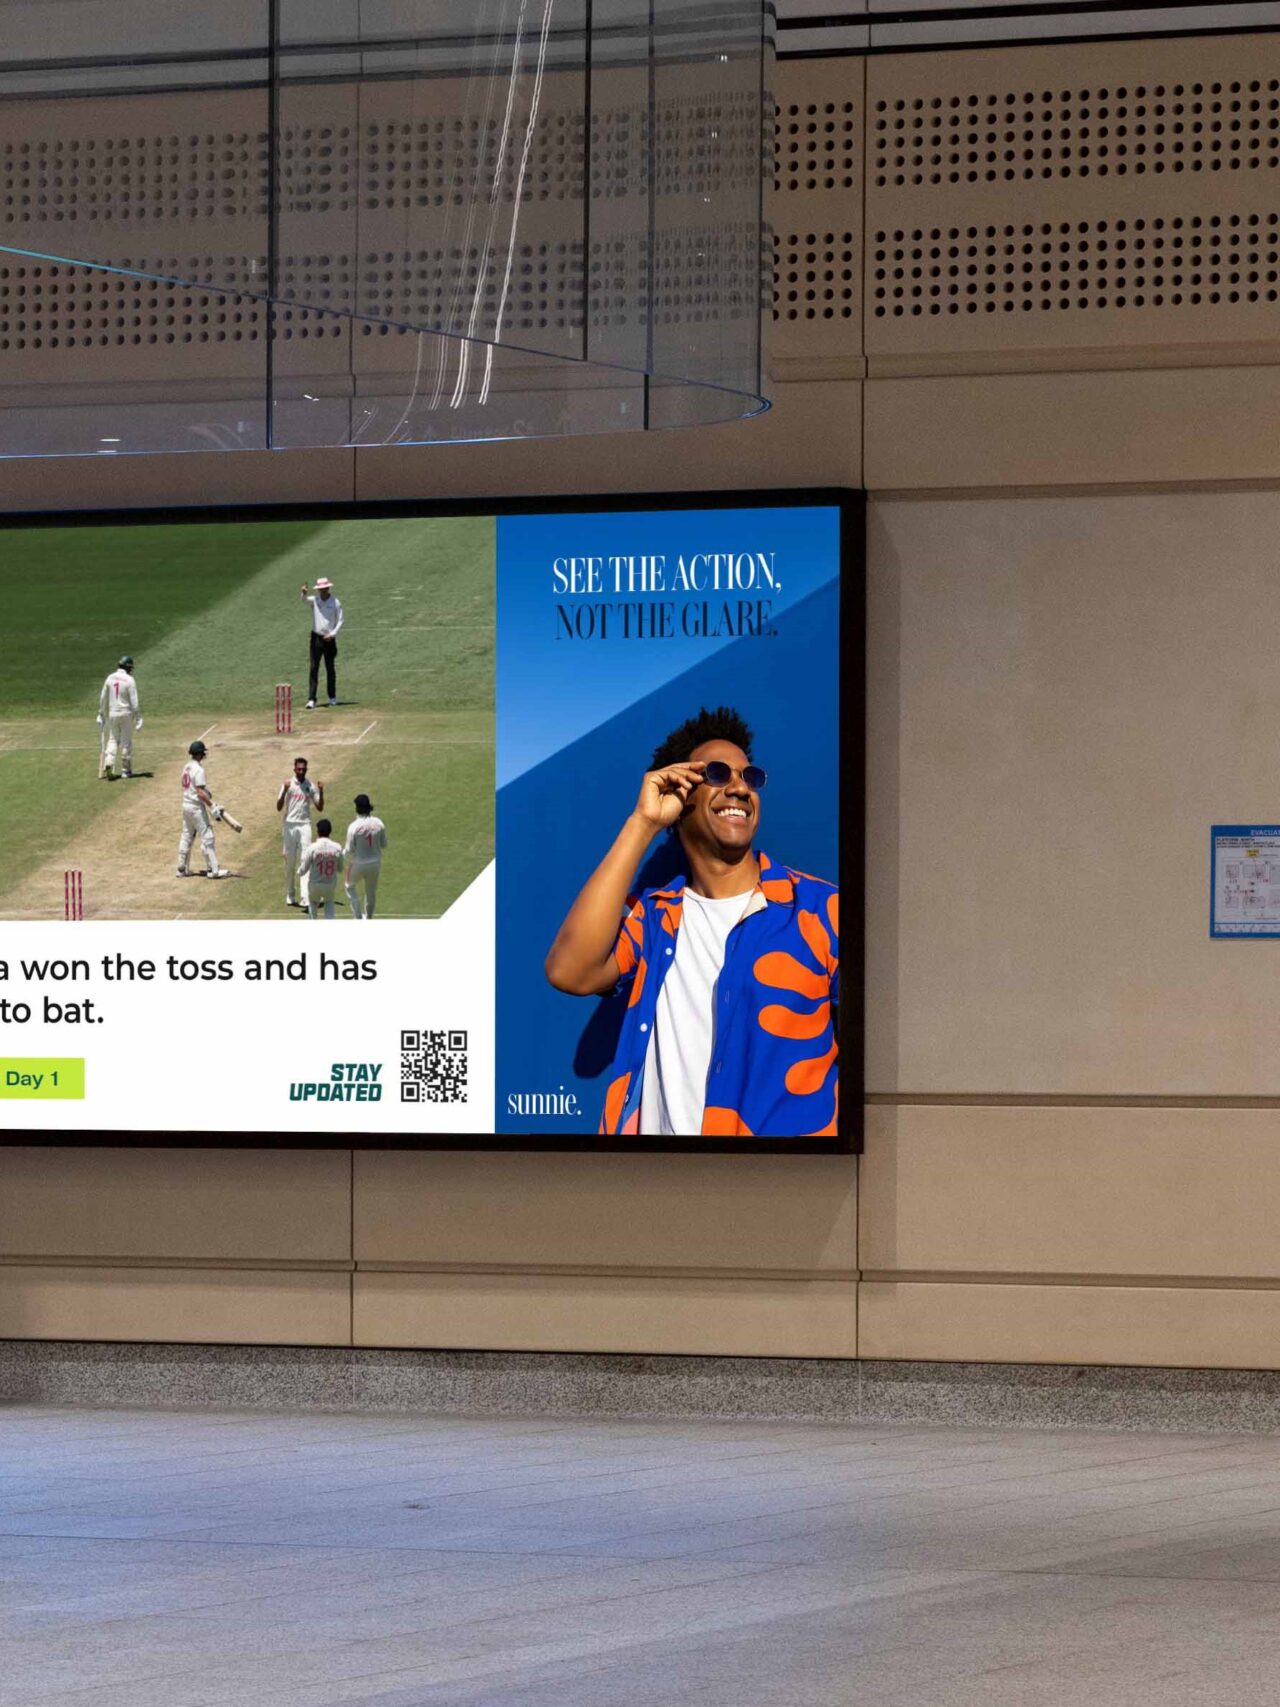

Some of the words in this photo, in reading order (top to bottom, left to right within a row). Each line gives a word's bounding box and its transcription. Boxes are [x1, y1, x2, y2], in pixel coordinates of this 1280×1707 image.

[553, 557, 604, 594] SEE
[609, 555, 666, 593] THE
[670, 552, 782, 592] ACTION,
[555, 604, 614, 641] NOT
[616, 602, 675, 639] THE
[681, 599, 780, 638] GLARE.
[20, 959, 90, 981] won
[101, 952, 156, 981] the
[166, 955, 234, 981] toss
[244, 952, 307, 981] and
[320, 952, 378, 981] has
[43, 995, 104, 1024] bat.
[6, 1070, 44, 1090] Day
[50, 1071, 59, 1087] 1
[330, 1063, 383, 1082] STAY
[288, 1083, 383, 1102] UPDATED
[507, 1085, 582, 1116] sunnie.
